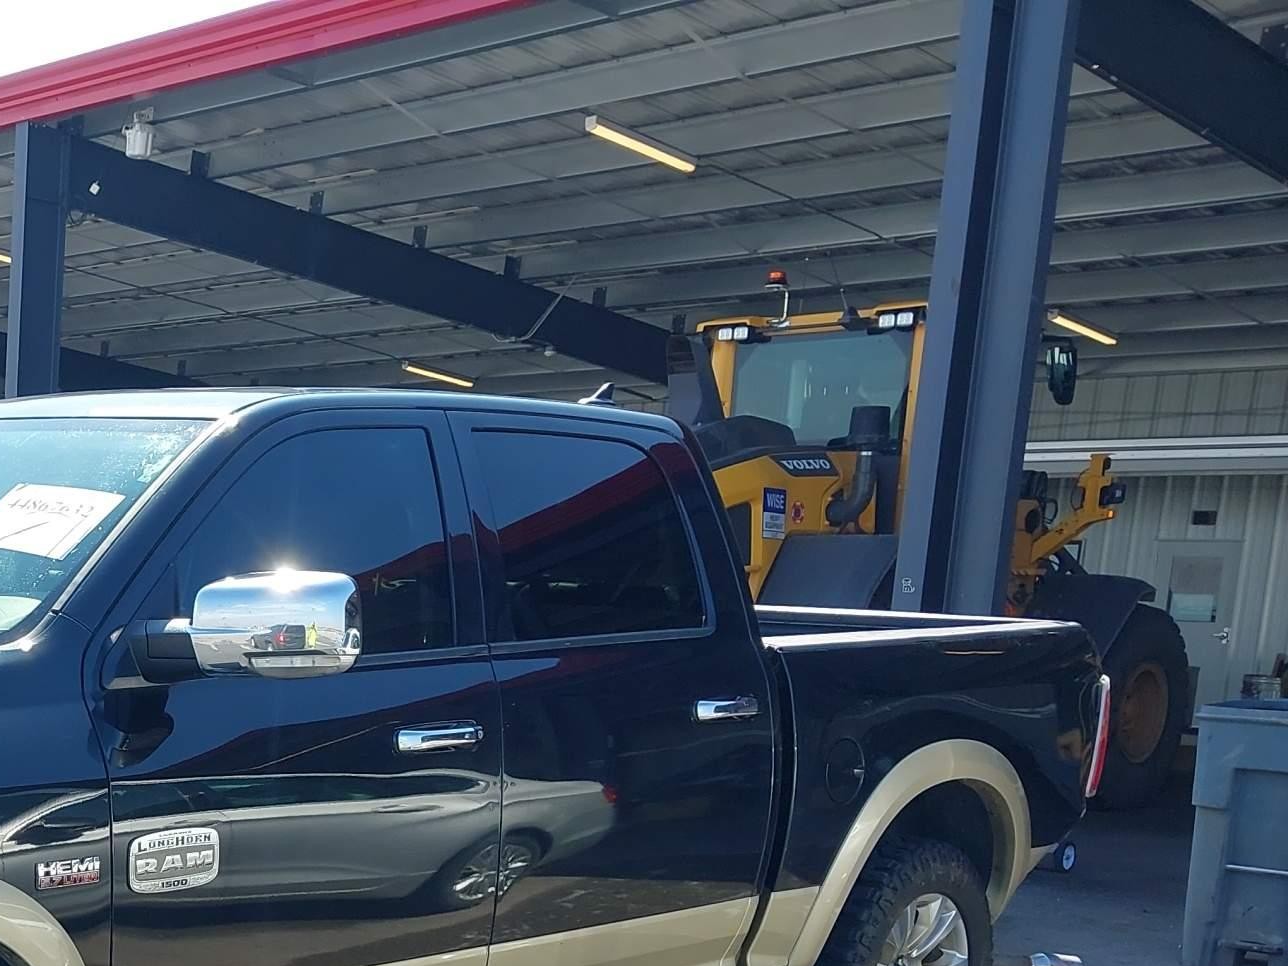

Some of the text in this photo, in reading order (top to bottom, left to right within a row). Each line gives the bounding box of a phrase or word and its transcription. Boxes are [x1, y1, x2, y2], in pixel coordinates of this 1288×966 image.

[780, 459, 831, 470] VOLVO
[766, 493, 785, 509] WISE
[37, 856, 101, 877] HEMI
[136, 850, 214, 876] RAM
[161, 878, 189, 889] 1500
